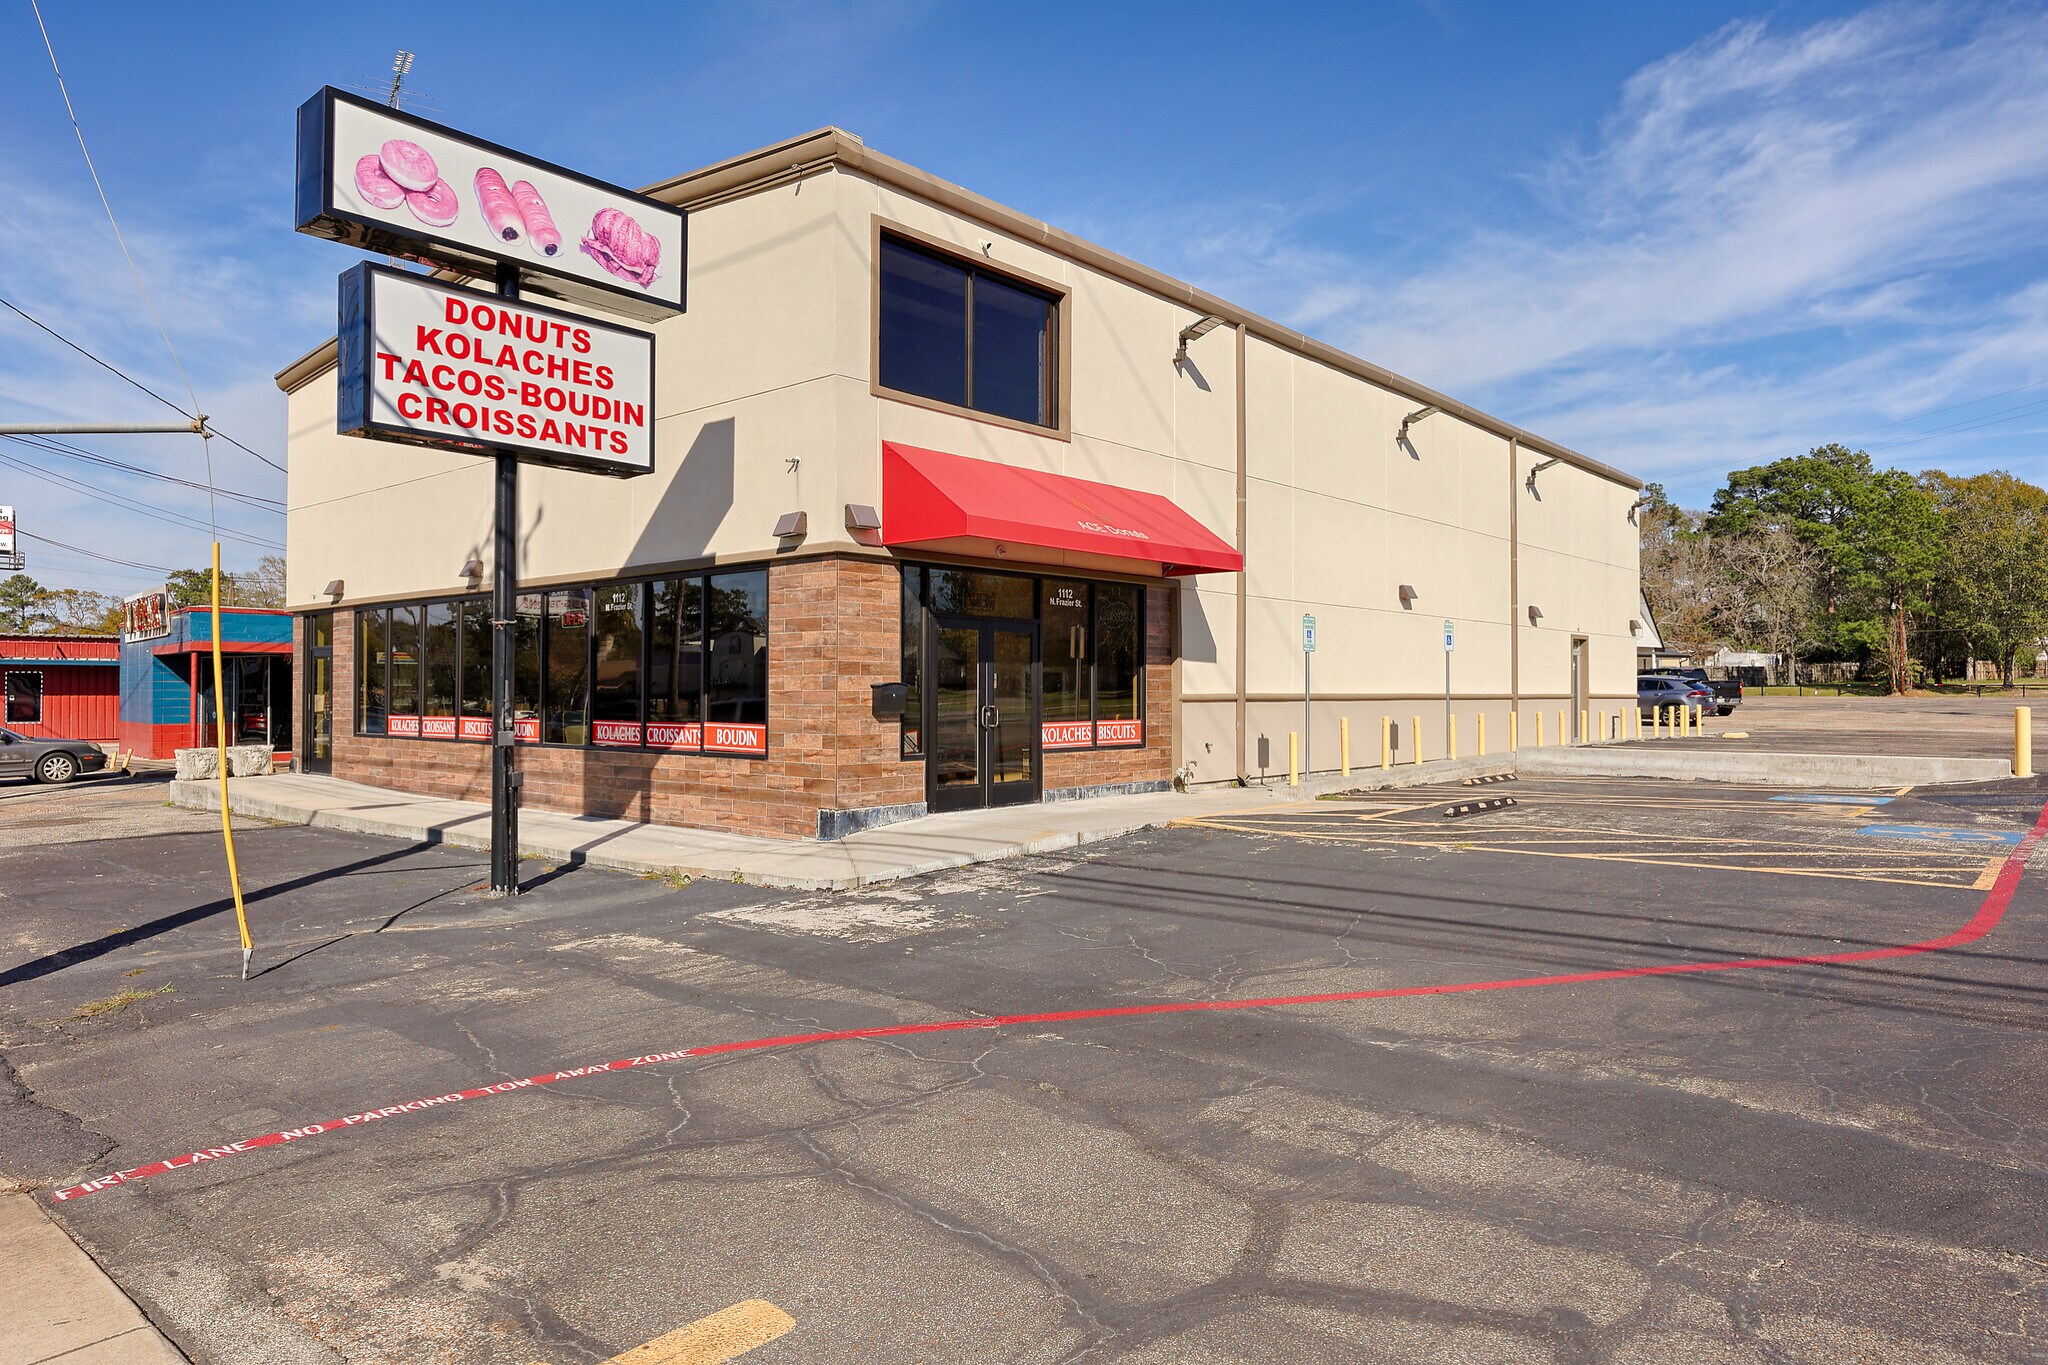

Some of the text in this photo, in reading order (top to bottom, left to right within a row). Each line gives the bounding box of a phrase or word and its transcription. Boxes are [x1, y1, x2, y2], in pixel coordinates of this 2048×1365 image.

[445, 297, 592, 354] DONUTS
[416, 325, 615, 390] KOLACHES
[377, 352, 644, 428] TACOS-BOUDIN
[397, 392, 630, 455] CROISSANTS
[612, 592, 626, 604] 1112
[1058, 588, 1074, 599] 1112
[563, 611, 584, 626] OPEN
[391, 719, 419, 732] KOLACHES
[422, 720, 456, 734] CROISSANT
[464, 721, 492, 736] BISCUITS
[597, 725, 641, 742] KOLACHES
[1098, 725, 1136, 740] BISCUITS
[716, 728, 758, 747] BOUDIN
[1042, 726, 1092, 743] KOLACHES
[55, 1049, 696, 1201] FIRE LANE NO PARKING TOW AWAY ZONE
